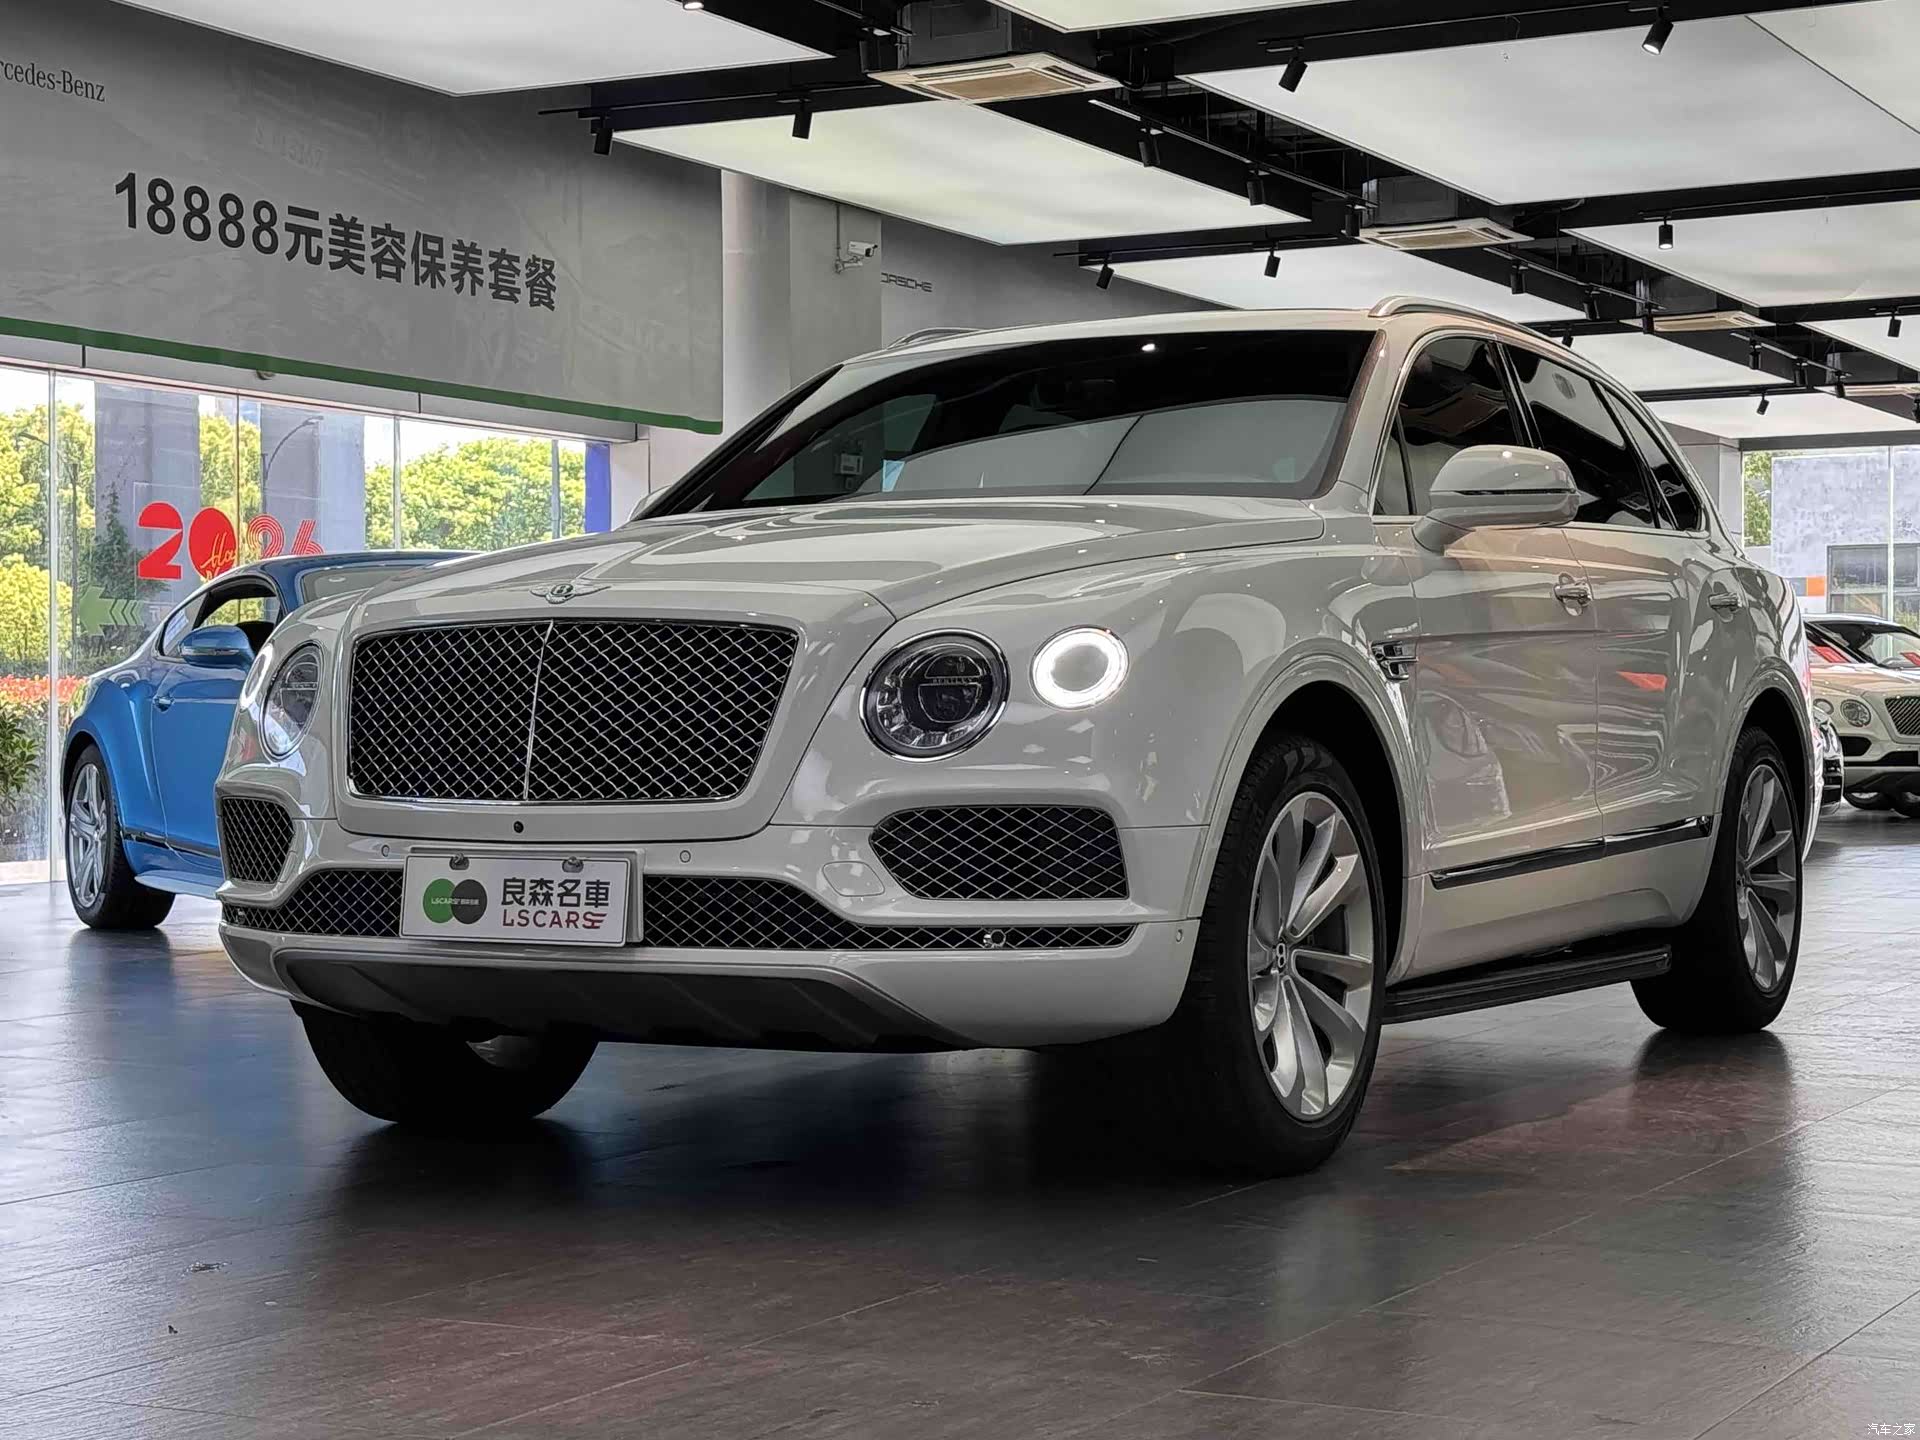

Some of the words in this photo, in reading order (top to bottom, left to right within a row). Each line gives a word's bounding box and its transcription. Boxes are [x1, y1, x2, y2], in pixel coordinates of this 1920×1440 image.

[0, 61, 105, 102] cedes-Benz
[115, 172, 557, 311] 18888元美容保养套餐
[881, 272, 933, 292] ORSCHE
[501, 877, 610, 908] 良森名車
